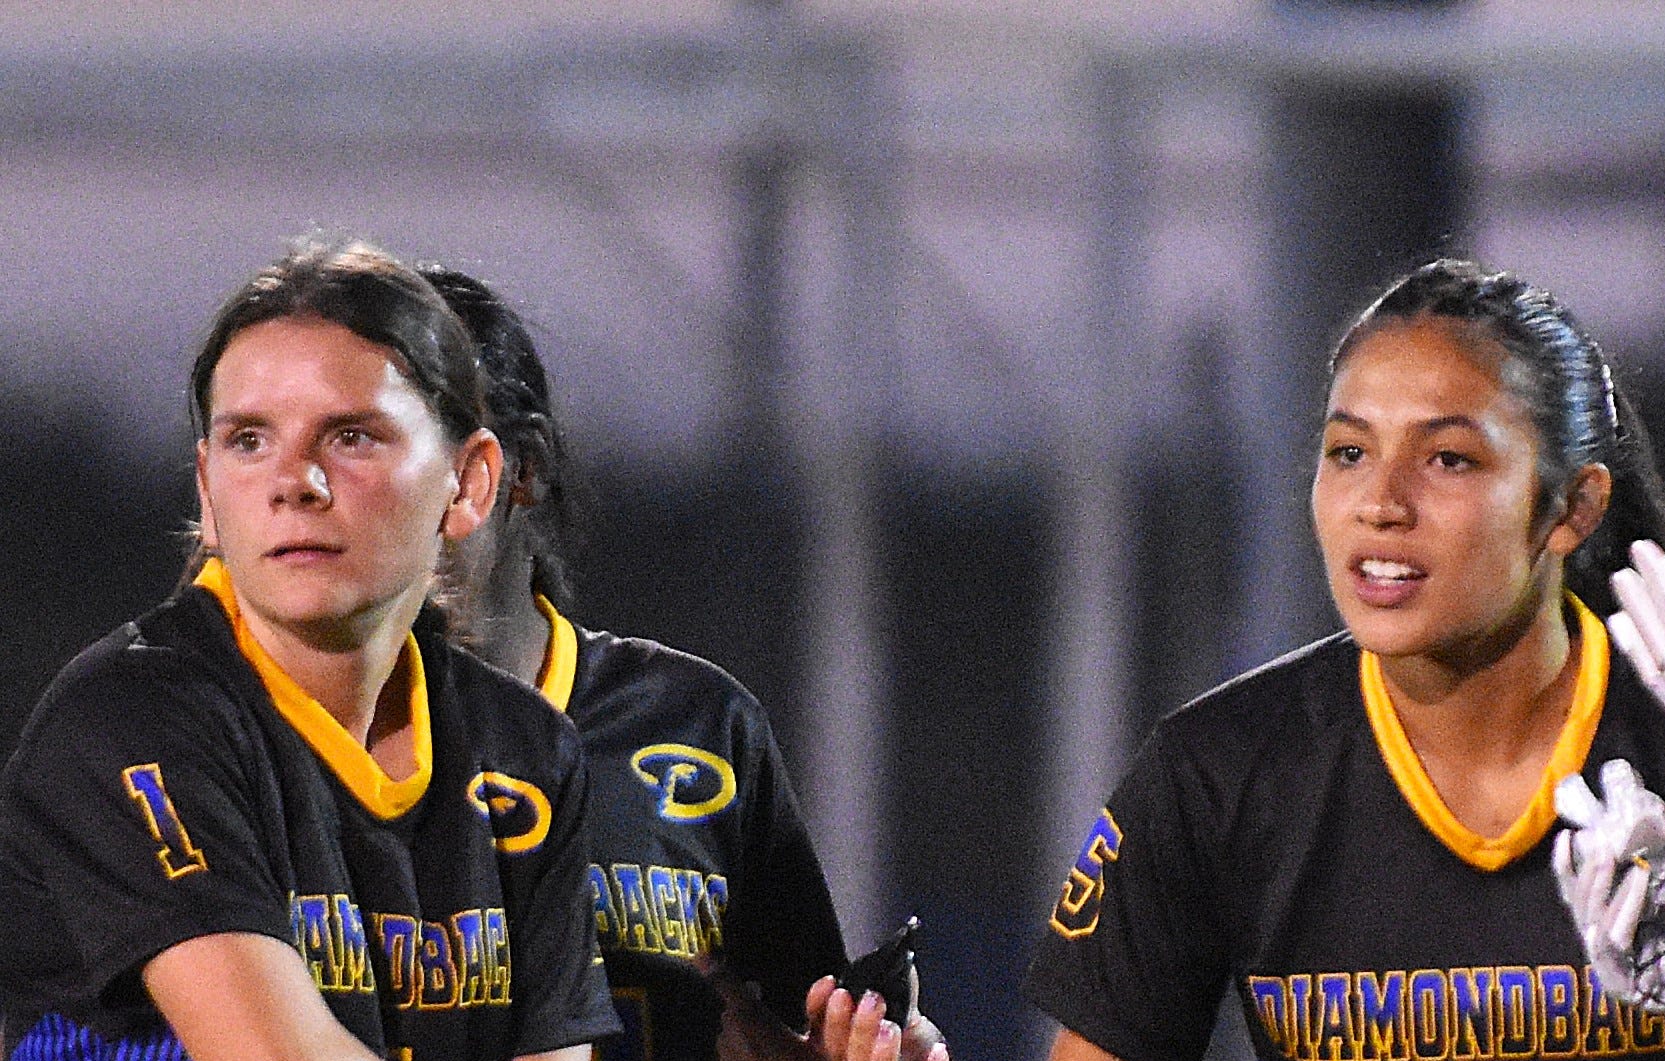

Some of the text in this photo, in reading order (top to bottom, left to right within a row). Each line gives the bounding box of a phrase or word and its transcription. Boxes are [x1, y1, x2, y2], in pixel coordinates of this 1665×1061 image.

[122, 762, 209, 879] 1
[630, 743, 738, 825] D
[1048, 808, 1124, 940] 5
